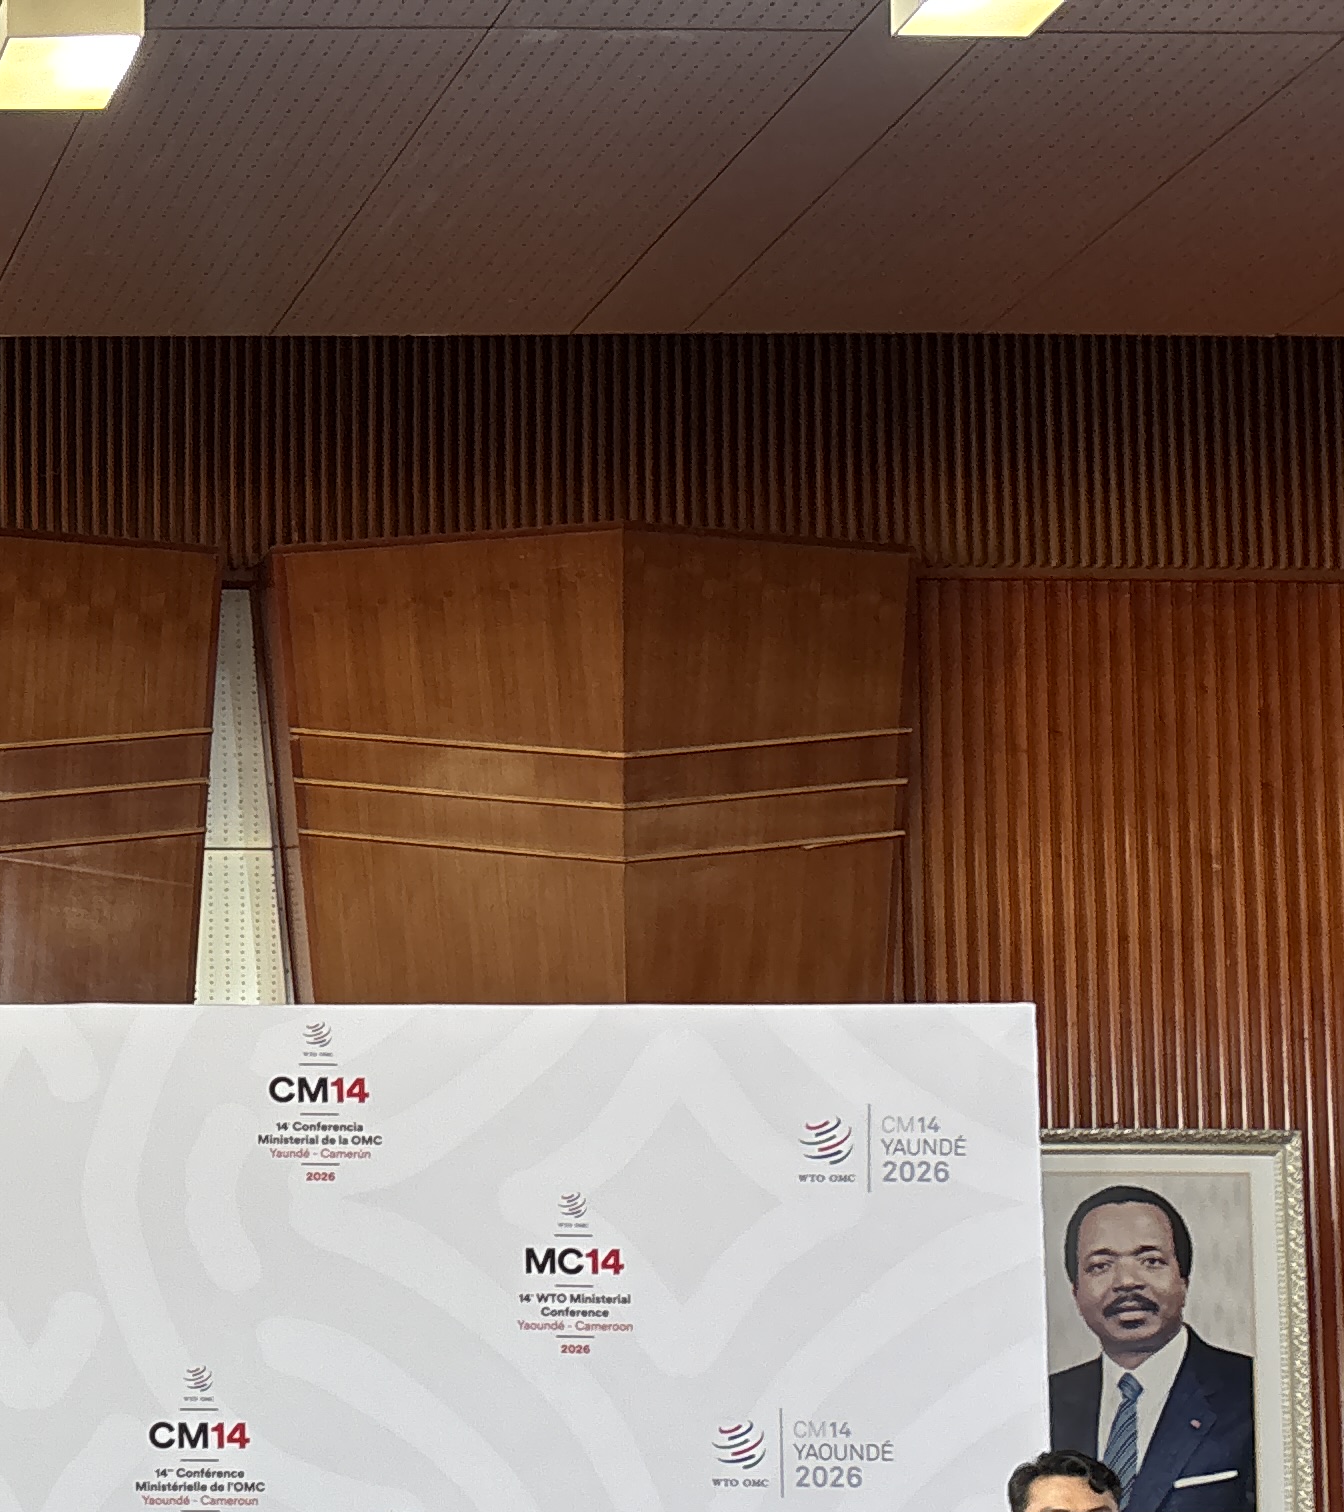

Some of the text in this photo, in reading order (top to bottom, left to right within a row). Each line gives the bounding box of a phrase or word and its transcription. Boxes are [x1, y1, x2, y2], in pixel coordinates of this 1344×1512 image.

[269, 1077, 369, 1103] CM14
[276, 1122, 363, 1131] 14 Conferencia
[881, 1115, 940, 1133] CM14
[258, 1135, 382, 1145] Ministerial de la OMC
[881, 1135, 967, 1156] YAUNDÉ
[270, 1148, 310, 1158] Yaundé
[306, 1172, 335, 1181] 2026
[883, 1161, 949, 1182] 2026
[799, 1174, 855, 1182] WTO OMC
[526, 1248, 624, 1275] MC14
[519, 1293, 631, 1304] 14 WTO Ministerial
[541, 1307, 609, 1317] Conference
[518, 1320, 633, 1331] Yaoundé Cameroon
[561, 1345, 590, 1354] 2026
[793, 1420, 851, 1438] CM14
[149, 1422, 250, 1449] CM14
[793, 1440, 894, 1461] YAOUNDÉ
[176, 1468, 244, 1478] Conférence
[796, 1465, 862, 1487] 2026
[135, 1482, 207, 1491] Ministérielle
[210, 1482, 224, 1491] de
[712, 1479, 769, 1487] WTO OMC
[142, 1495, 258, 1505] Yaoundé Cameroun
